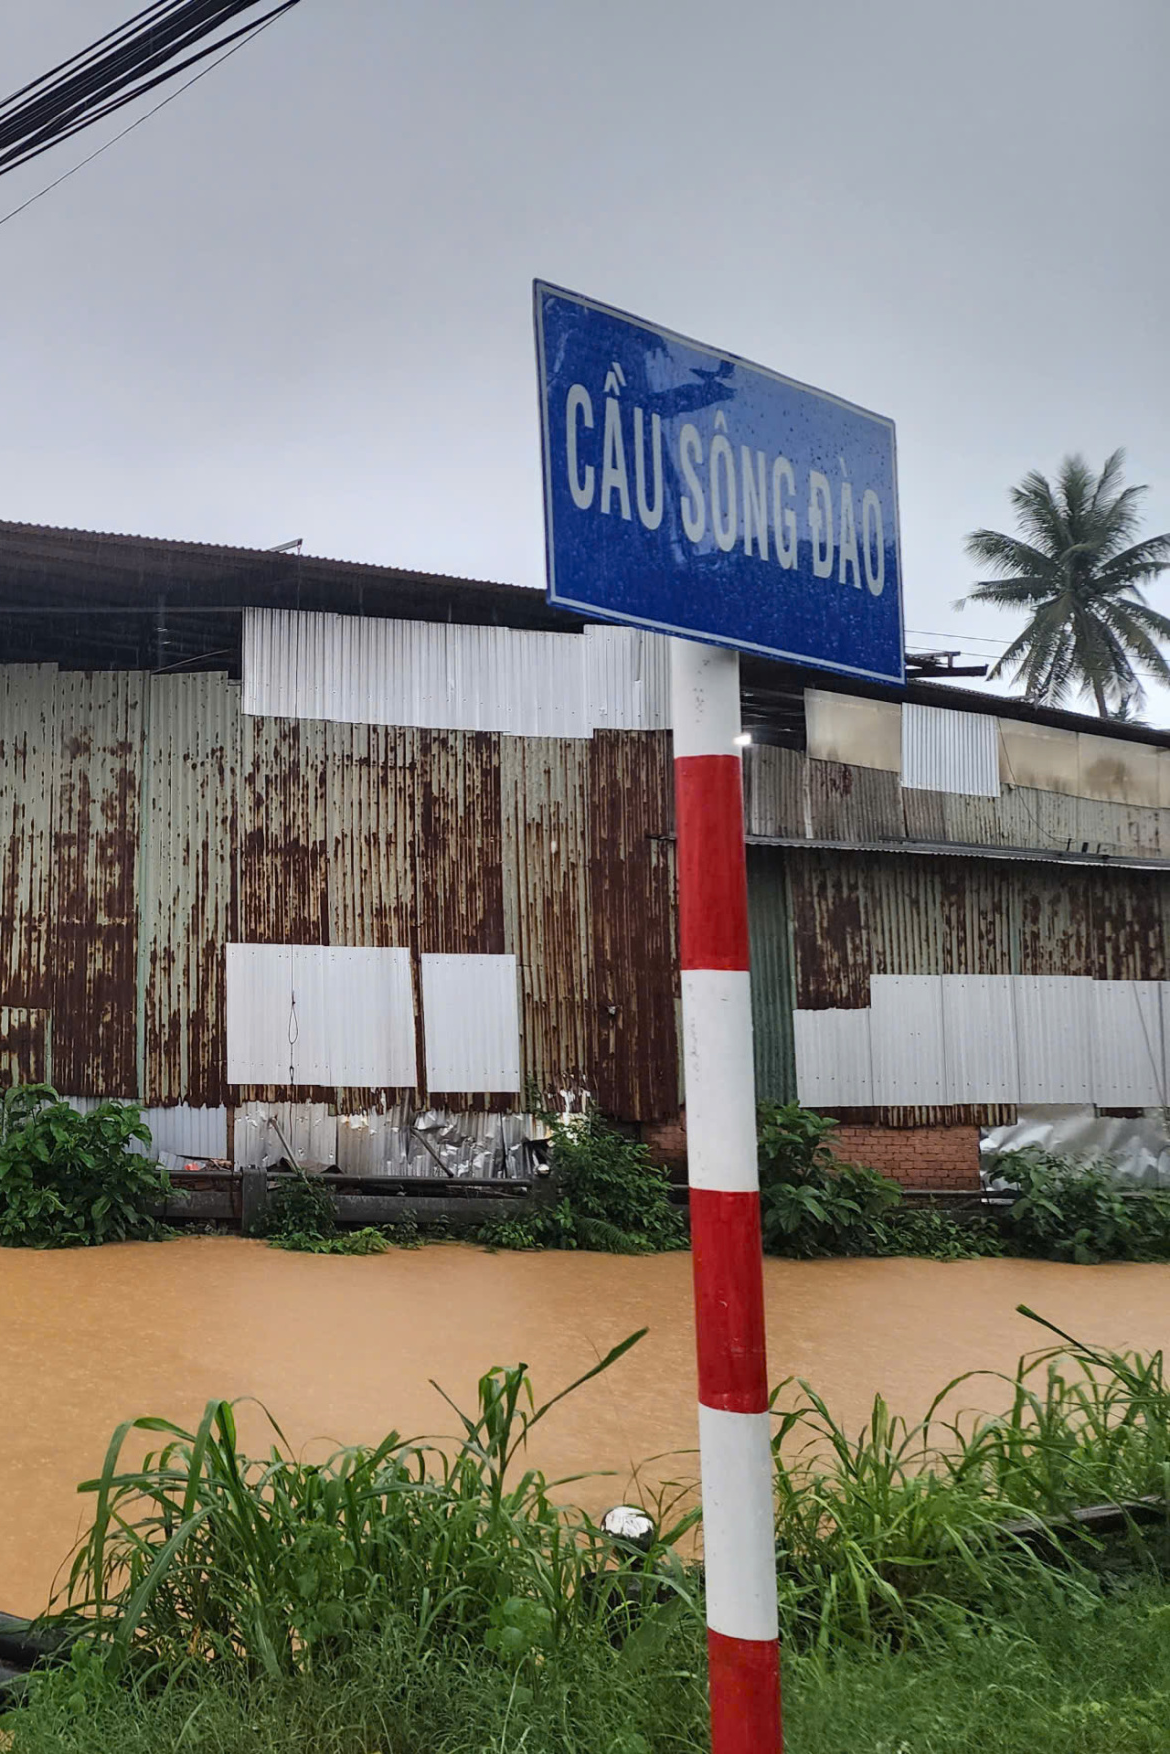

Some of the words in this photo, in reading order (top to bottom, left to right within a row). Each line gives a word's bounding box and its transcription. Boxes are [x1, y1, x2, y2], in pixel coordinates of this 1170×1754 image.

[566, 362, 664, 530] CẦU
[680, 410, 798, 570] SÔNG
[808, 457, 885, 597] ĐÀO
